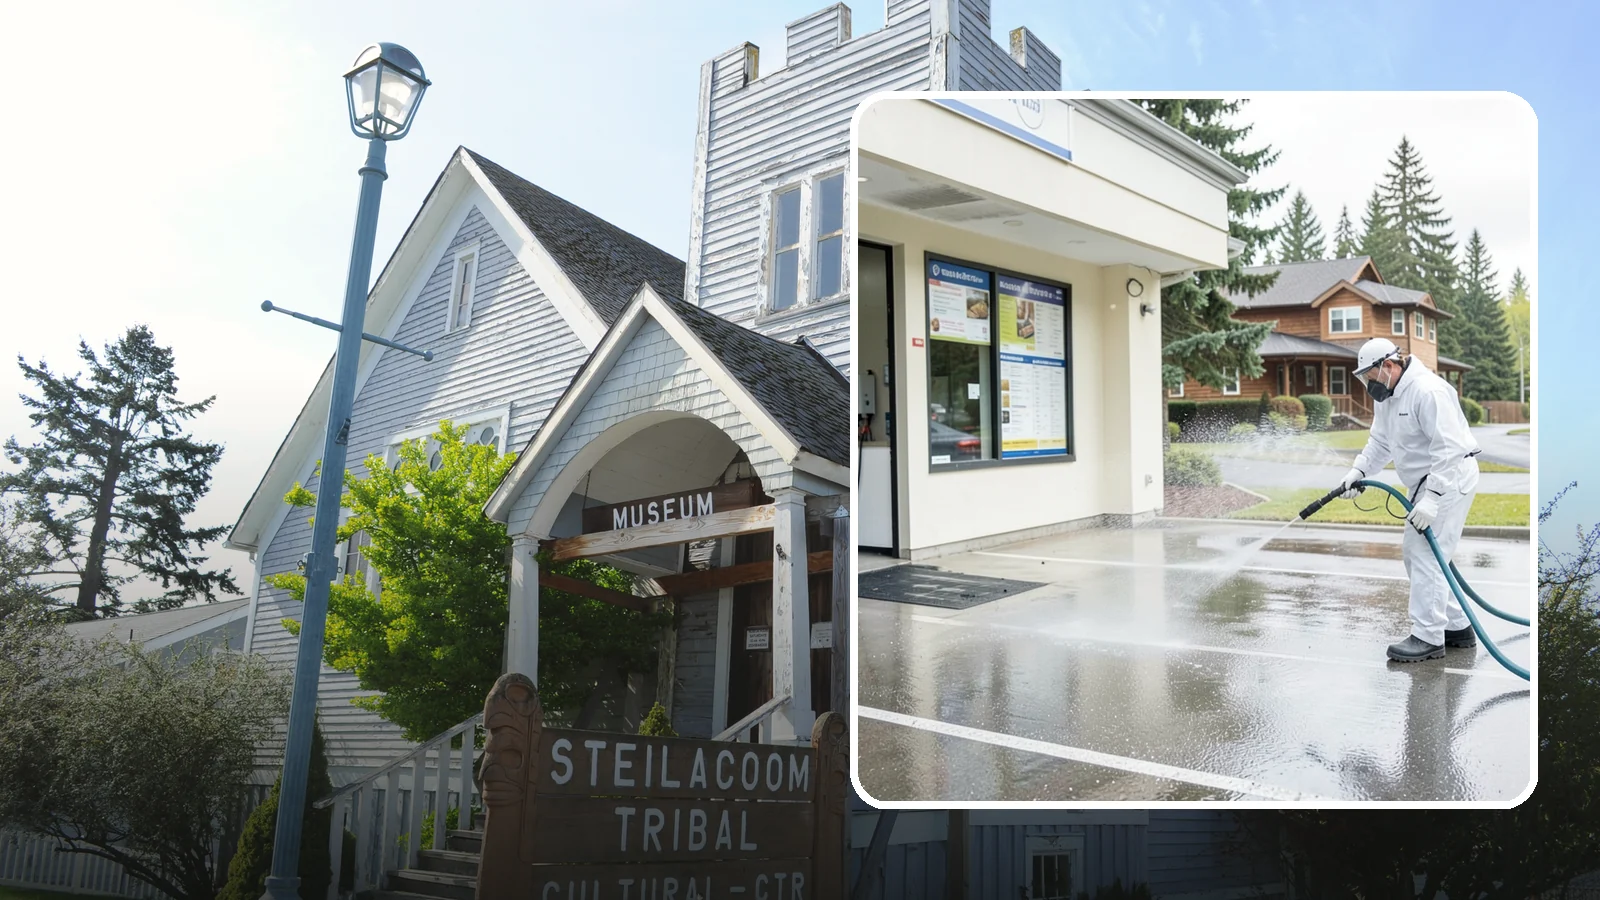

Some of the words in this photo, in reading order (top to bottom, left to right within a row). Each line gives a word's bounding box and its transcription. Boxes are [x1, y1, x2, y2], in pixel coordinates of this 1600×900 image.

[613, 491, 713, 531] MUSEUM
[550, 738, 810, 792] STEILACOOM
[615, 806, 758, 851] TRIBAL
